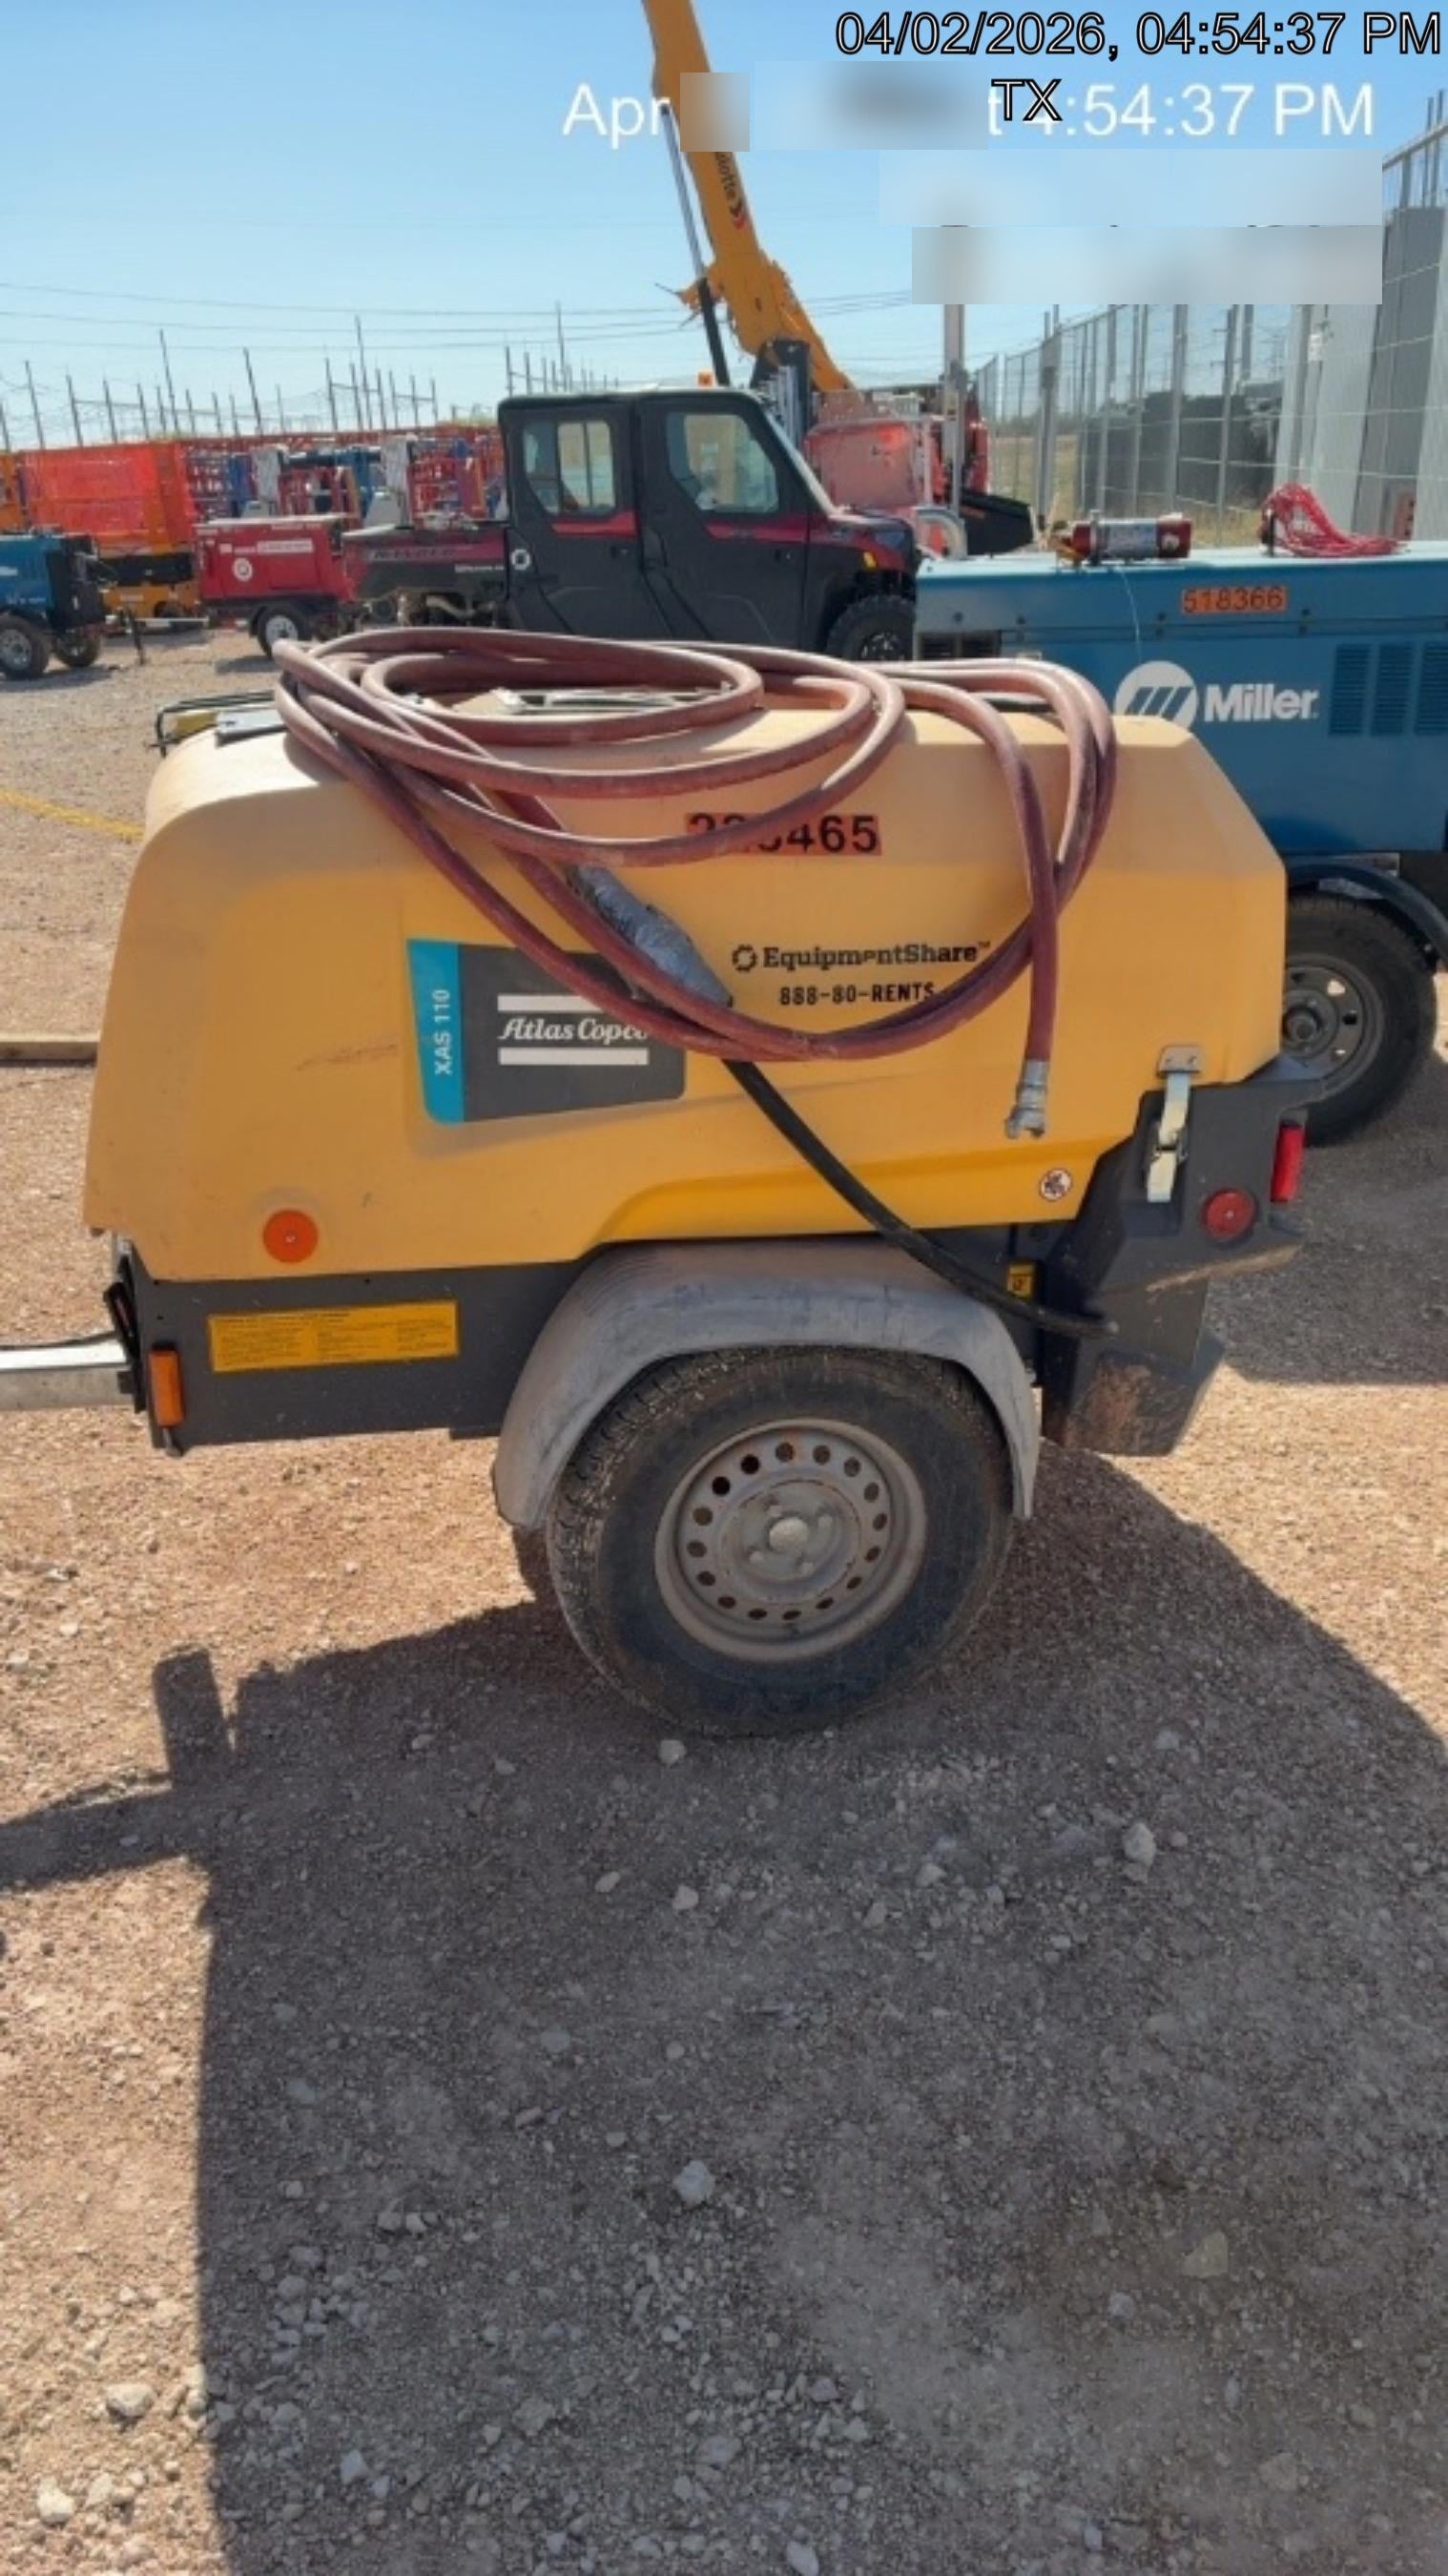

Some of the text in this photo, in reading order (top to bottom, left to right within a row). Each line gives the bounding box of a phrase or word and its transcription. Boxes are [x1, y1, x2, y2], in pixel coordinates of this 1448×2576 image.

[1183, 586, 1284, 613] 518366
[1204, 683, 1319, 722] Miller
[689, 813, 878, 853] 465
[779, 981, 935, 1007] 888-80-RENTS
[432, 988, 453, 1076] XAS 110
[497, 1017, 573, 1041] Atlas
